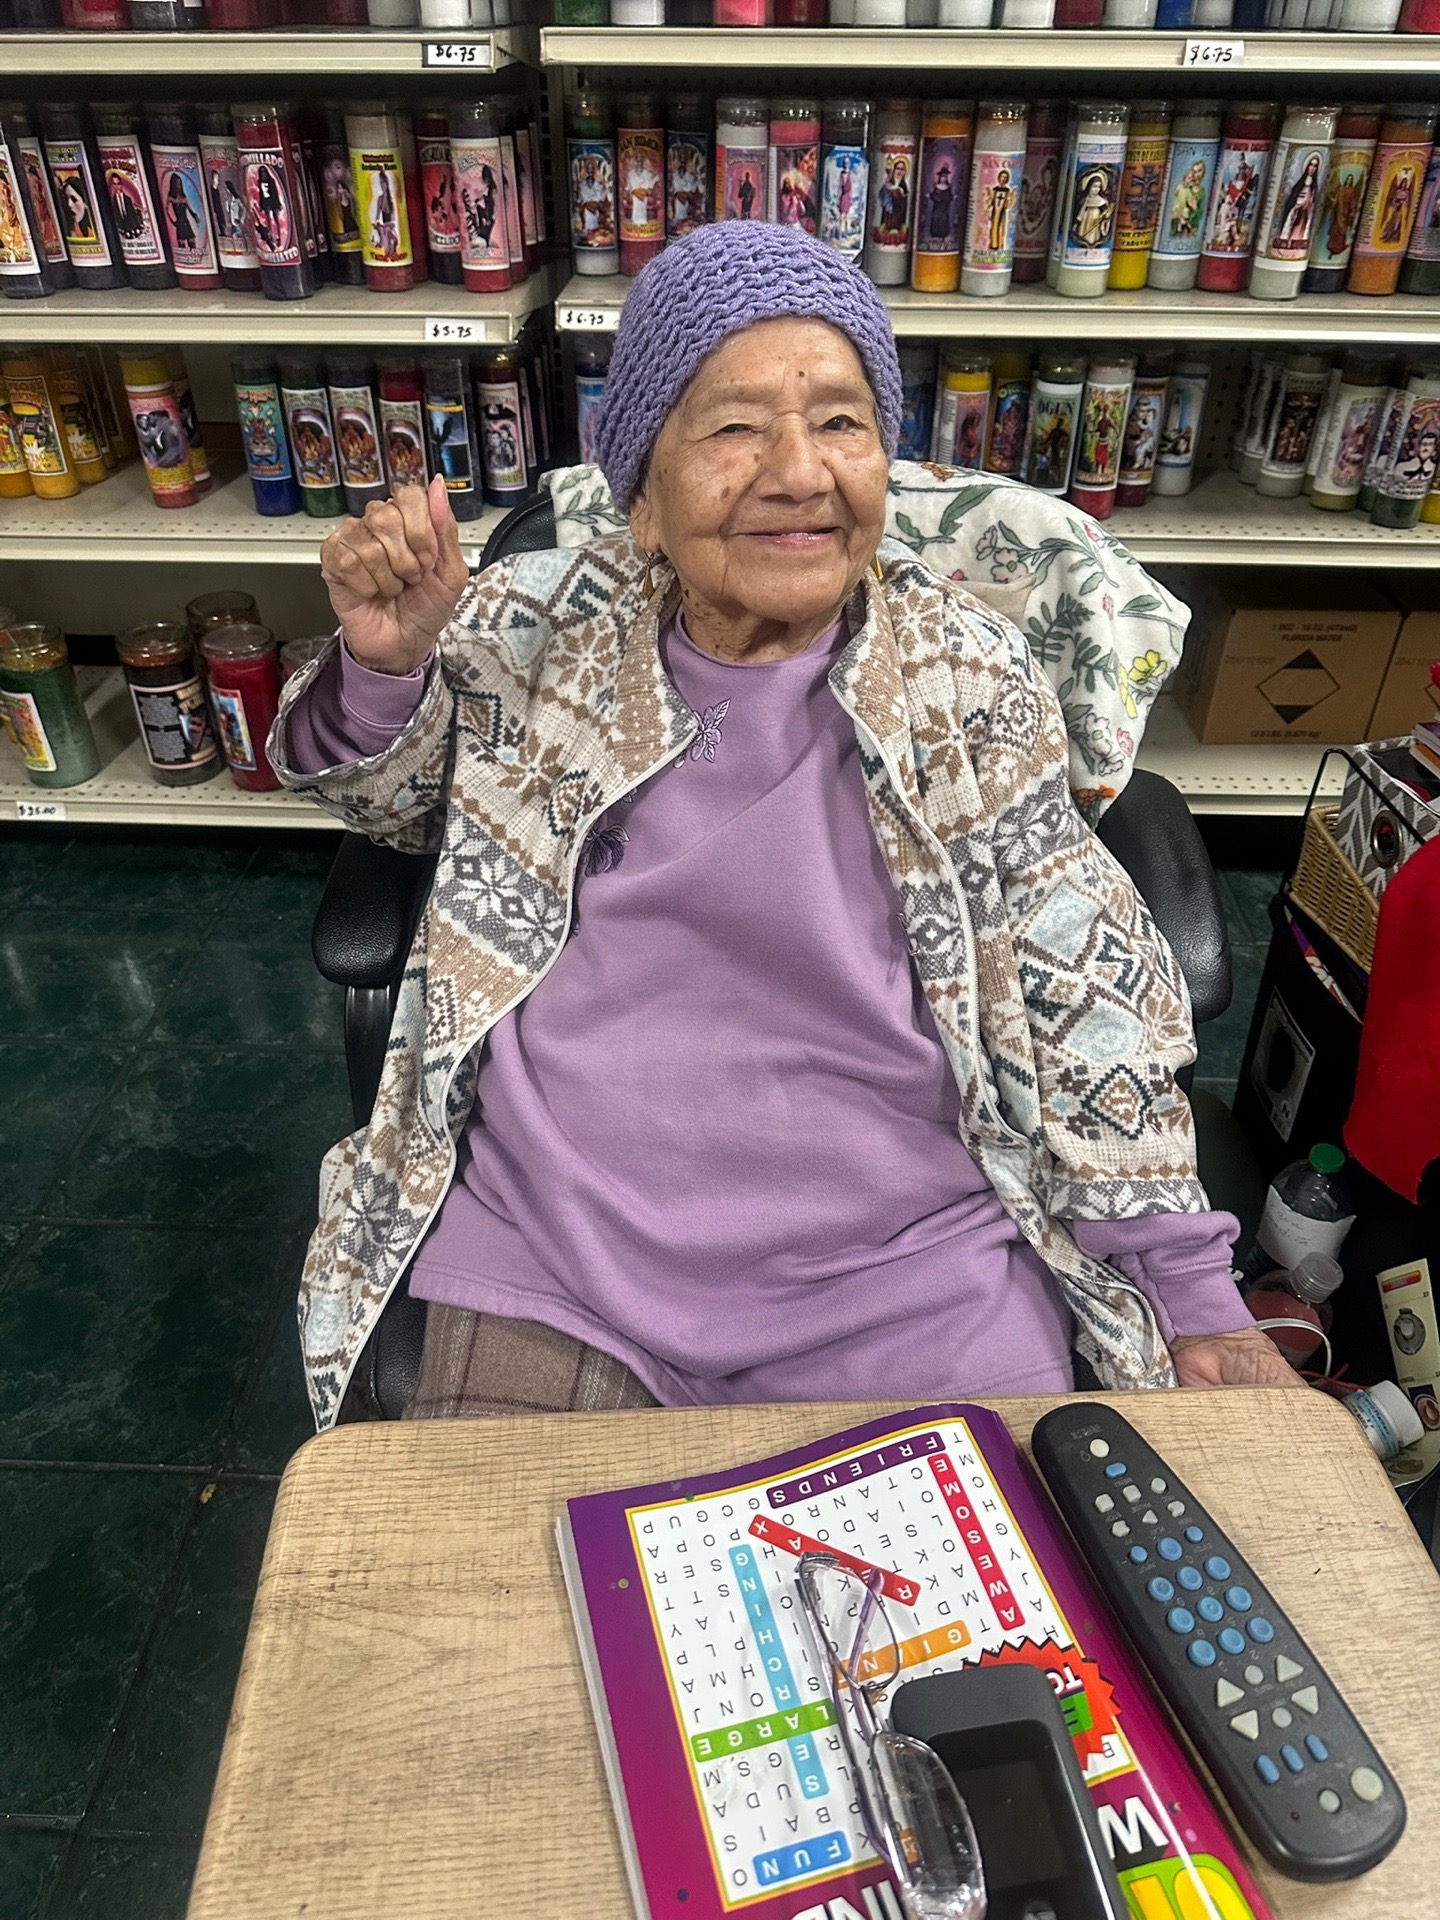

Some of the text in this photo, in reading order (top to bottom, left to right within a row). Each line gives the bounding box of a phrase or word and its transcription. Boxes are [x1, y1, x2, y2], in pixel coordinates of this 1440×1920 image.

[1190, 45, 1233, 65] $6.75
[773, 1437, 939, 1504] FRIENDS
[934, 1458, 1018, 1623] AWESOME
[696, 1704, 831, 1756] LARGE
[761, 1841, 842, 1878] FUN
